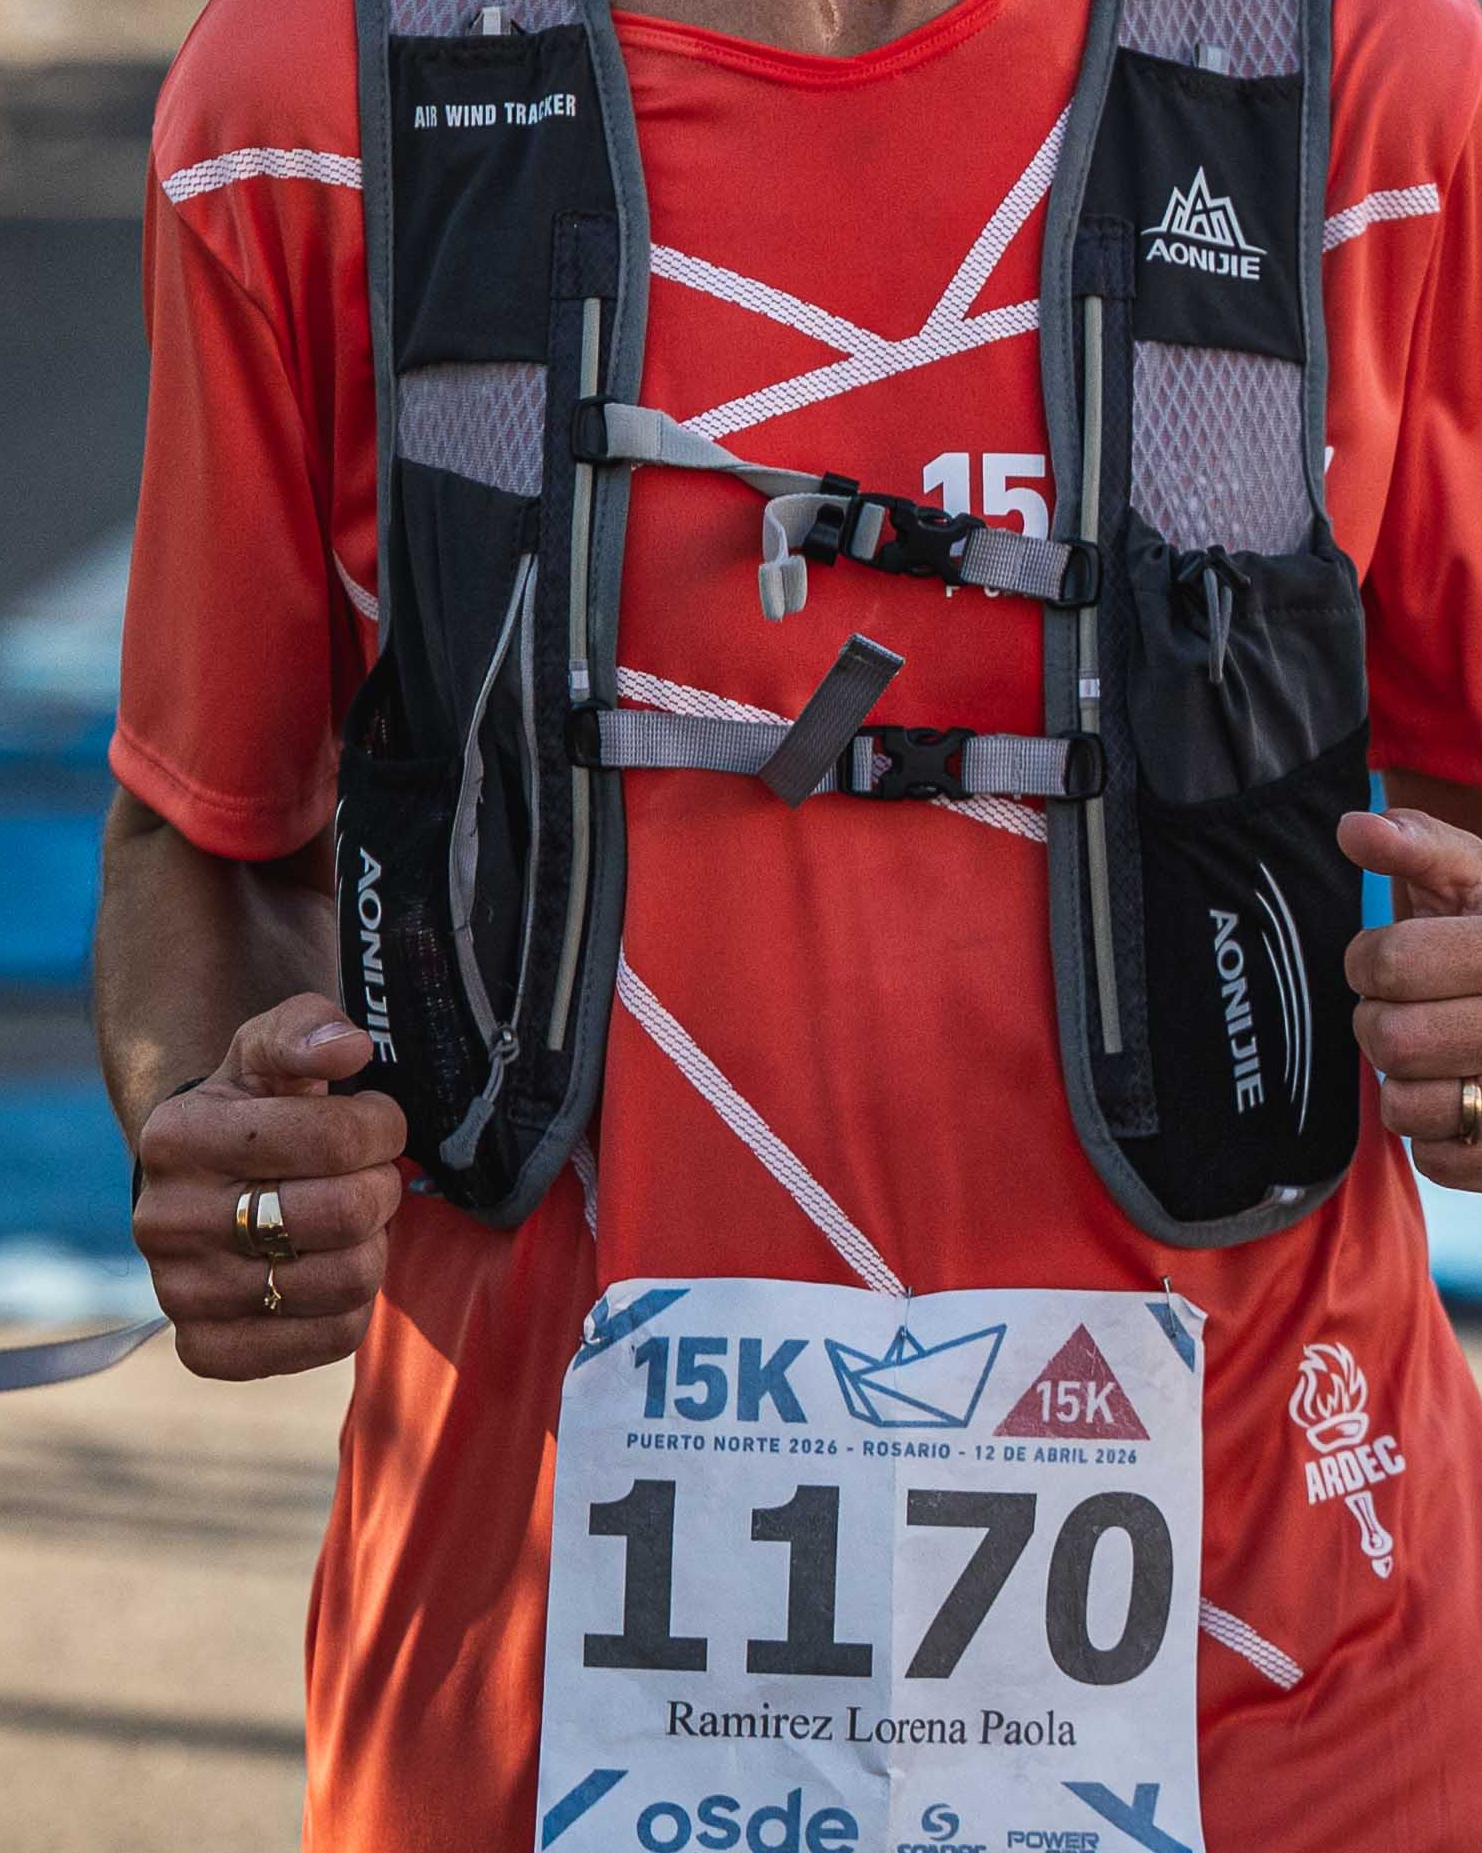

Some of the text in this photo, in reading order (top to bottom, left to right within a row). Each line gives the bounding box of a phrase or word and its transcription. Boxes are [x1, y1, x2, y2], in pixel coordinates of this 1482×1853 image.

[414, 93, 577, 128] AIR WIND TRACKER
[1145, 238, 1261, 281] AONIJIE
[1209, 908, 1265, 1114] AONIJIE
[633, 1335, 810, 1424] 15K
[1035, 1379, 1115, 1425] 15K
[626, 1433, 706, 1451] PUERTO
[713, 1435, 781, 1453] NORTE
[788, 1438, 838, 1455] 2026
[862, 1440, 951, 1459] ROSARIO
[974, 1445, 996, 1461] 12
[1003, 1446, 1026, 1462] DE
[1033, 1446, 1089, 1464] ABRIL
[1094, 1448, 1138, 1465] 2026
[1304, 1434, 1407, 1505] ARDEC
[583, 1479, 1175, 1686] 1170
[665, 1700, 1077, 1746] Ramirez Lorena Paola
[636, 1787, 859, 1853] osde
[1006, 1830, 1100, 1850] POWER
